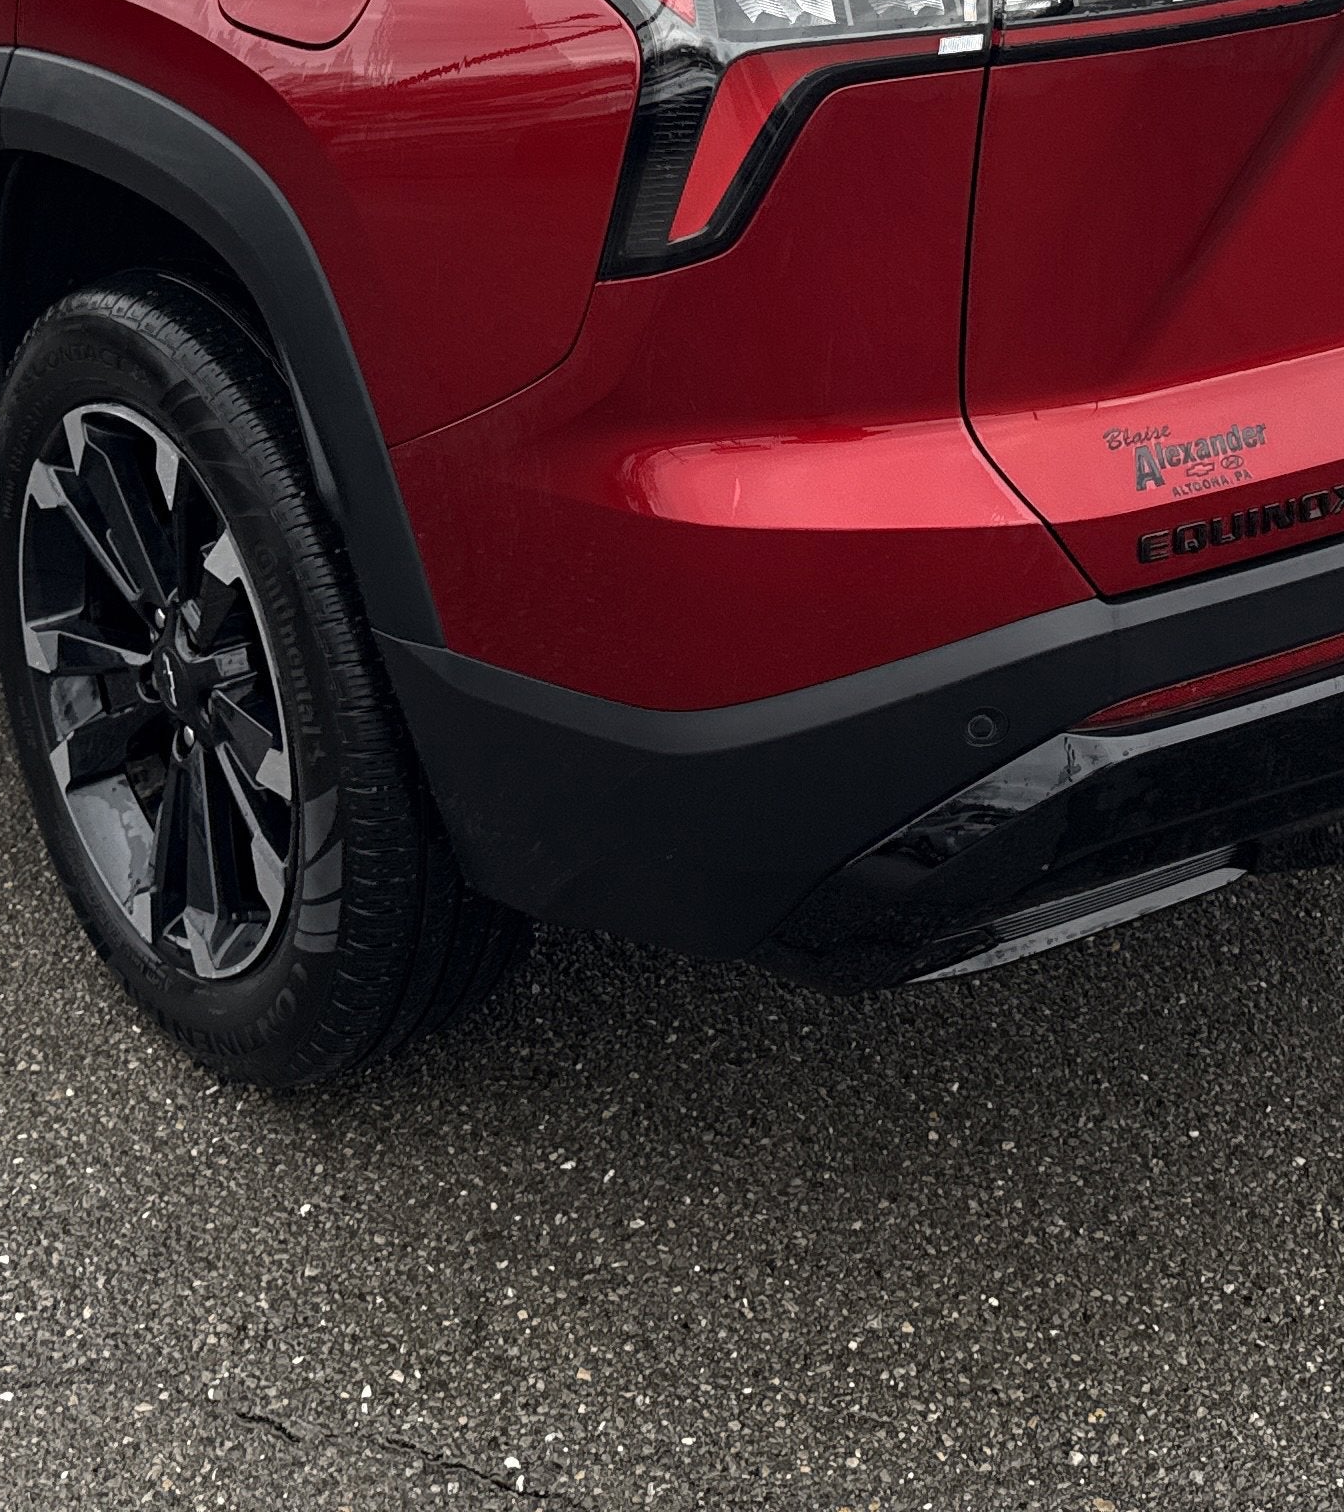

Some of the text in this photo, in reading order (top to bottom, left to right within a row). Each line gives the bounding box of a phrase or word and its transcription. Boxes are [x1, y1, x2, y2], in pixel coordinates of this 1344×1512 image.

[1103, 425, 1172, 451] Blaise
[1134, 423, 1267, 492] Alexander
[1234, 468, 1253, 484] PA
